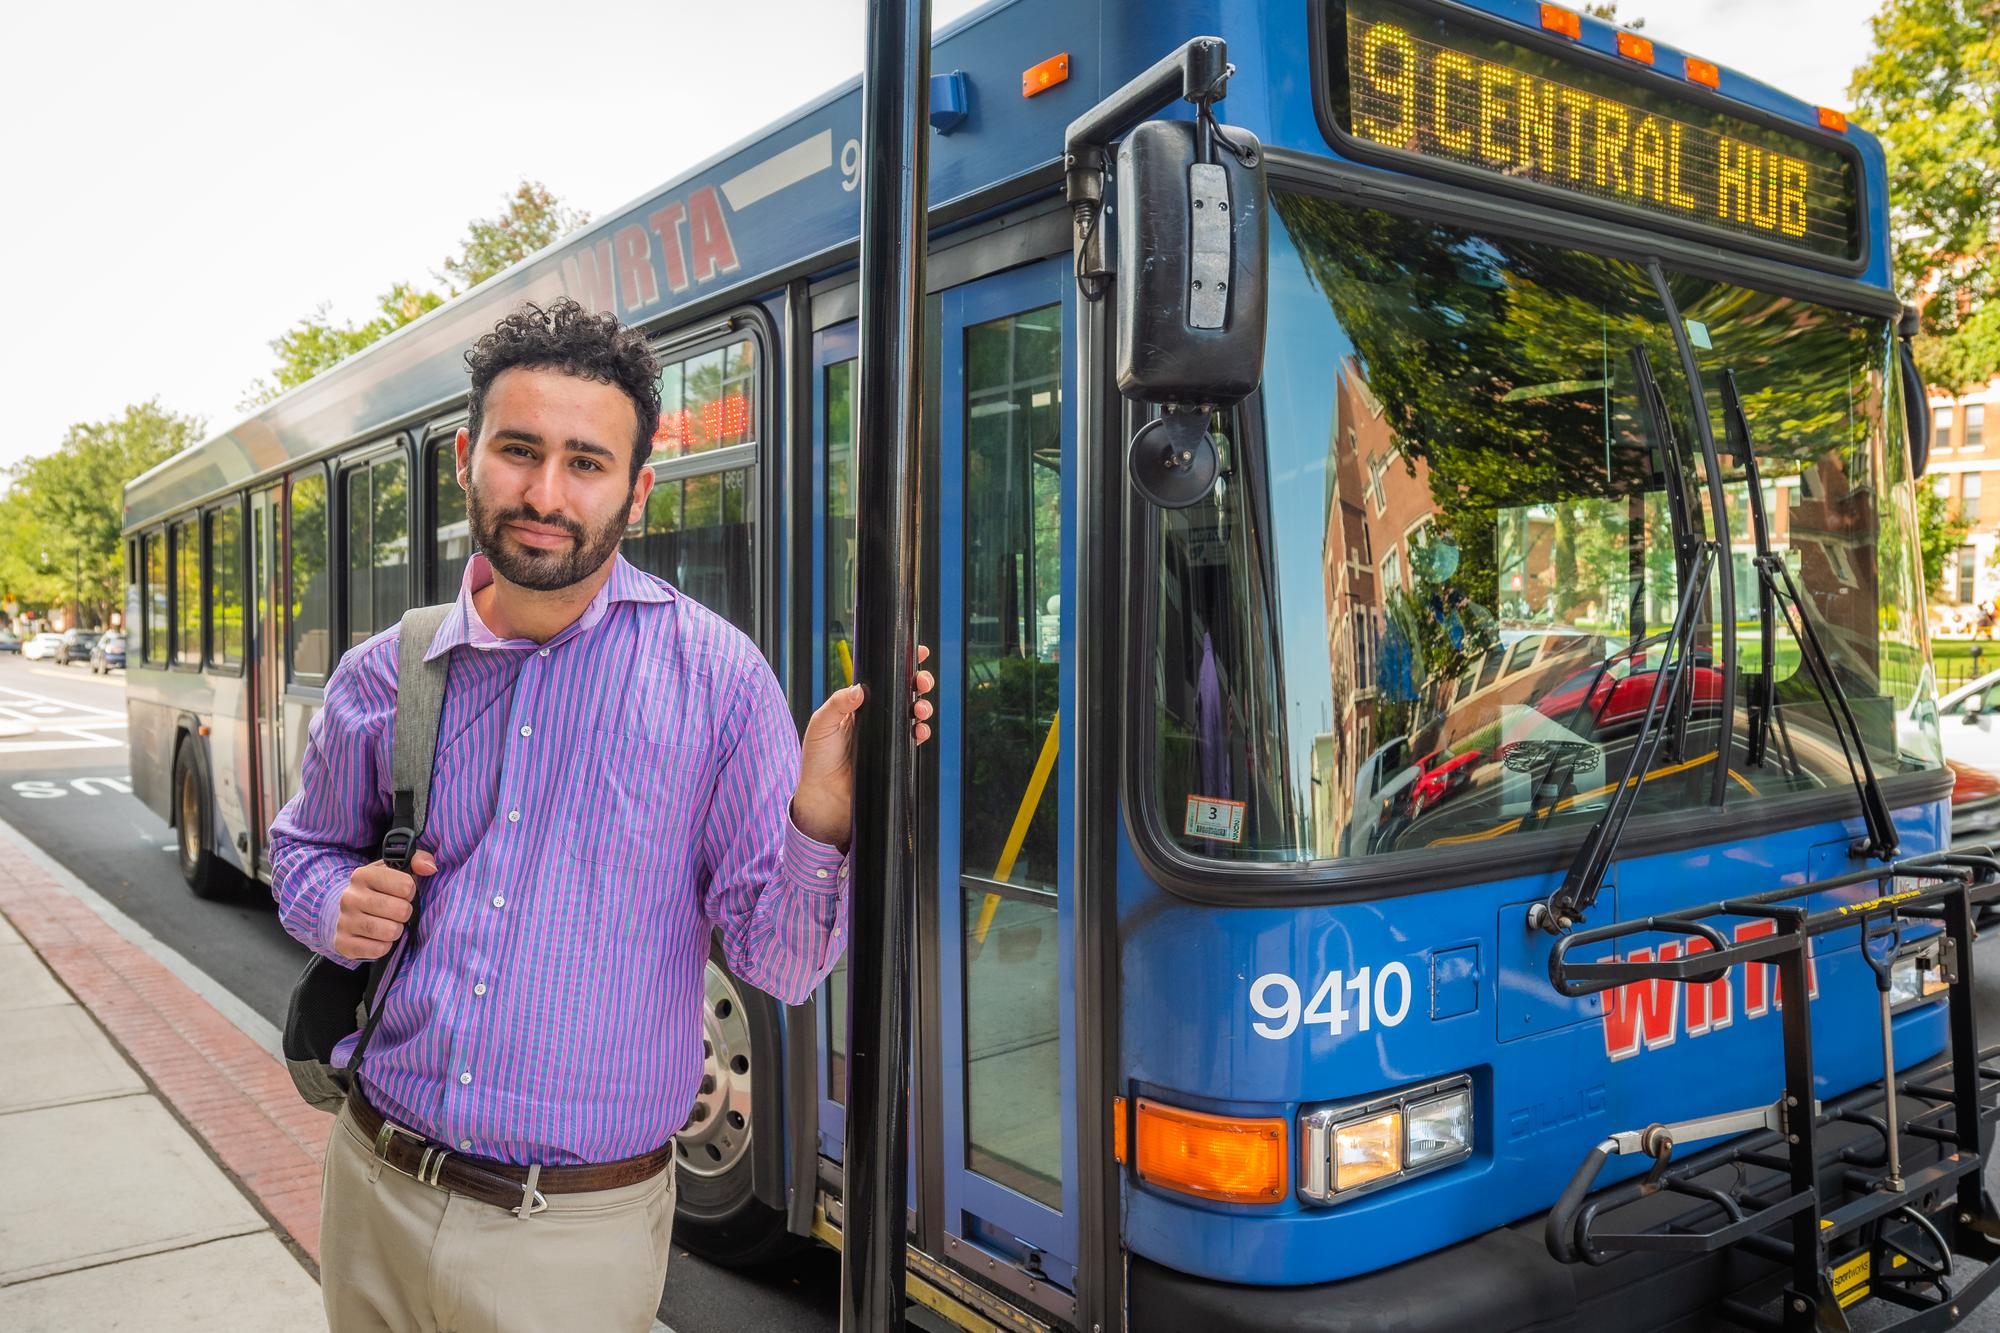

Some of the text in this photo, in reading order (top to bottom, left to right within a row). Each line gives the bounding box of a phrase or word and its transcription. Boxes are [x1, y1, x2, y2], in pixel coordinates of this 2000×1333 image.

[1351, 22, 1807, 237] 9 CENTRAL HUB
[561, 184, 741, 317] WRTA
[703, 396, 747, 440] HUB
[11, 776, 133, 798] US
[1208, 806, 1218, 820] 3
[1250, 961, 1411, 1040] 9410
[1507, 1083, 1606, 1143] GILLIG
